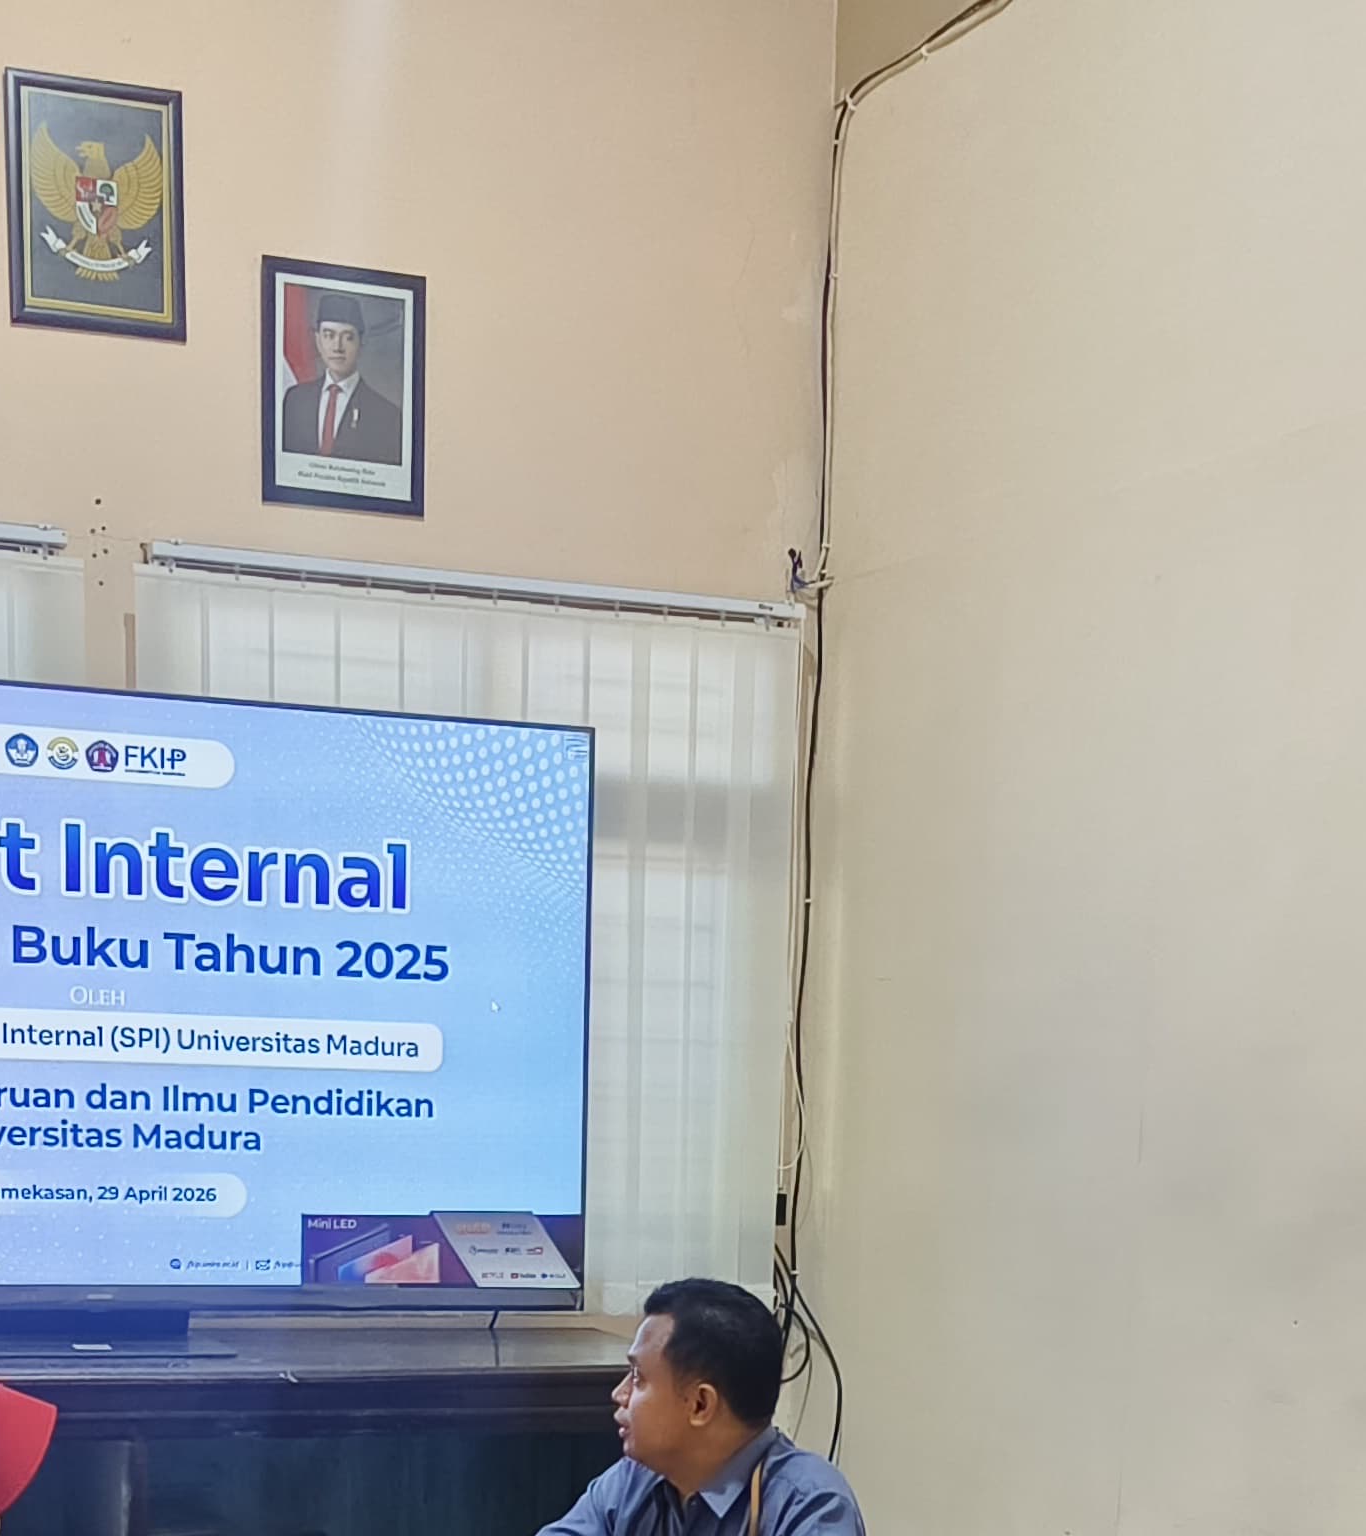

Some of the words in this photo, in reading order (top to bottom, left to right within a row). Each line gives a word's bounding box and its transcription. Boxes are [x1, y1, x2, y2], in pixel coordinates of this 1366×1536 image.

[124, 745, 187, 770] FKIP
[62, 820, 410, 912] Internal
[11, 924, 150, 970] Buku
[162, 931, 322, 977] Tahun
[335, 939, 450, 982] 2025
[1, 1022, 104, 1049] Internal
[110, 1024, 171, 1055] (SPI)
[176, 1028, 321, 1055] Universitas
[326, 1033, 420, 1058] Madura
[84, 1082, 152, 1112] dan
[162, 1084, 238, 1114] Ilmu
[248, 1087, 435, 1119] Pendidikan
[132, 1121, 262, 1152] Madura
[97, 1185, 120, 1202] 29
[124, 1185, 168, 1205] April
[172, 1186, 218, 1203] 2026
[307, 1218, 332, 1230] Mini
[333, 1218, 358, 1230] LED
